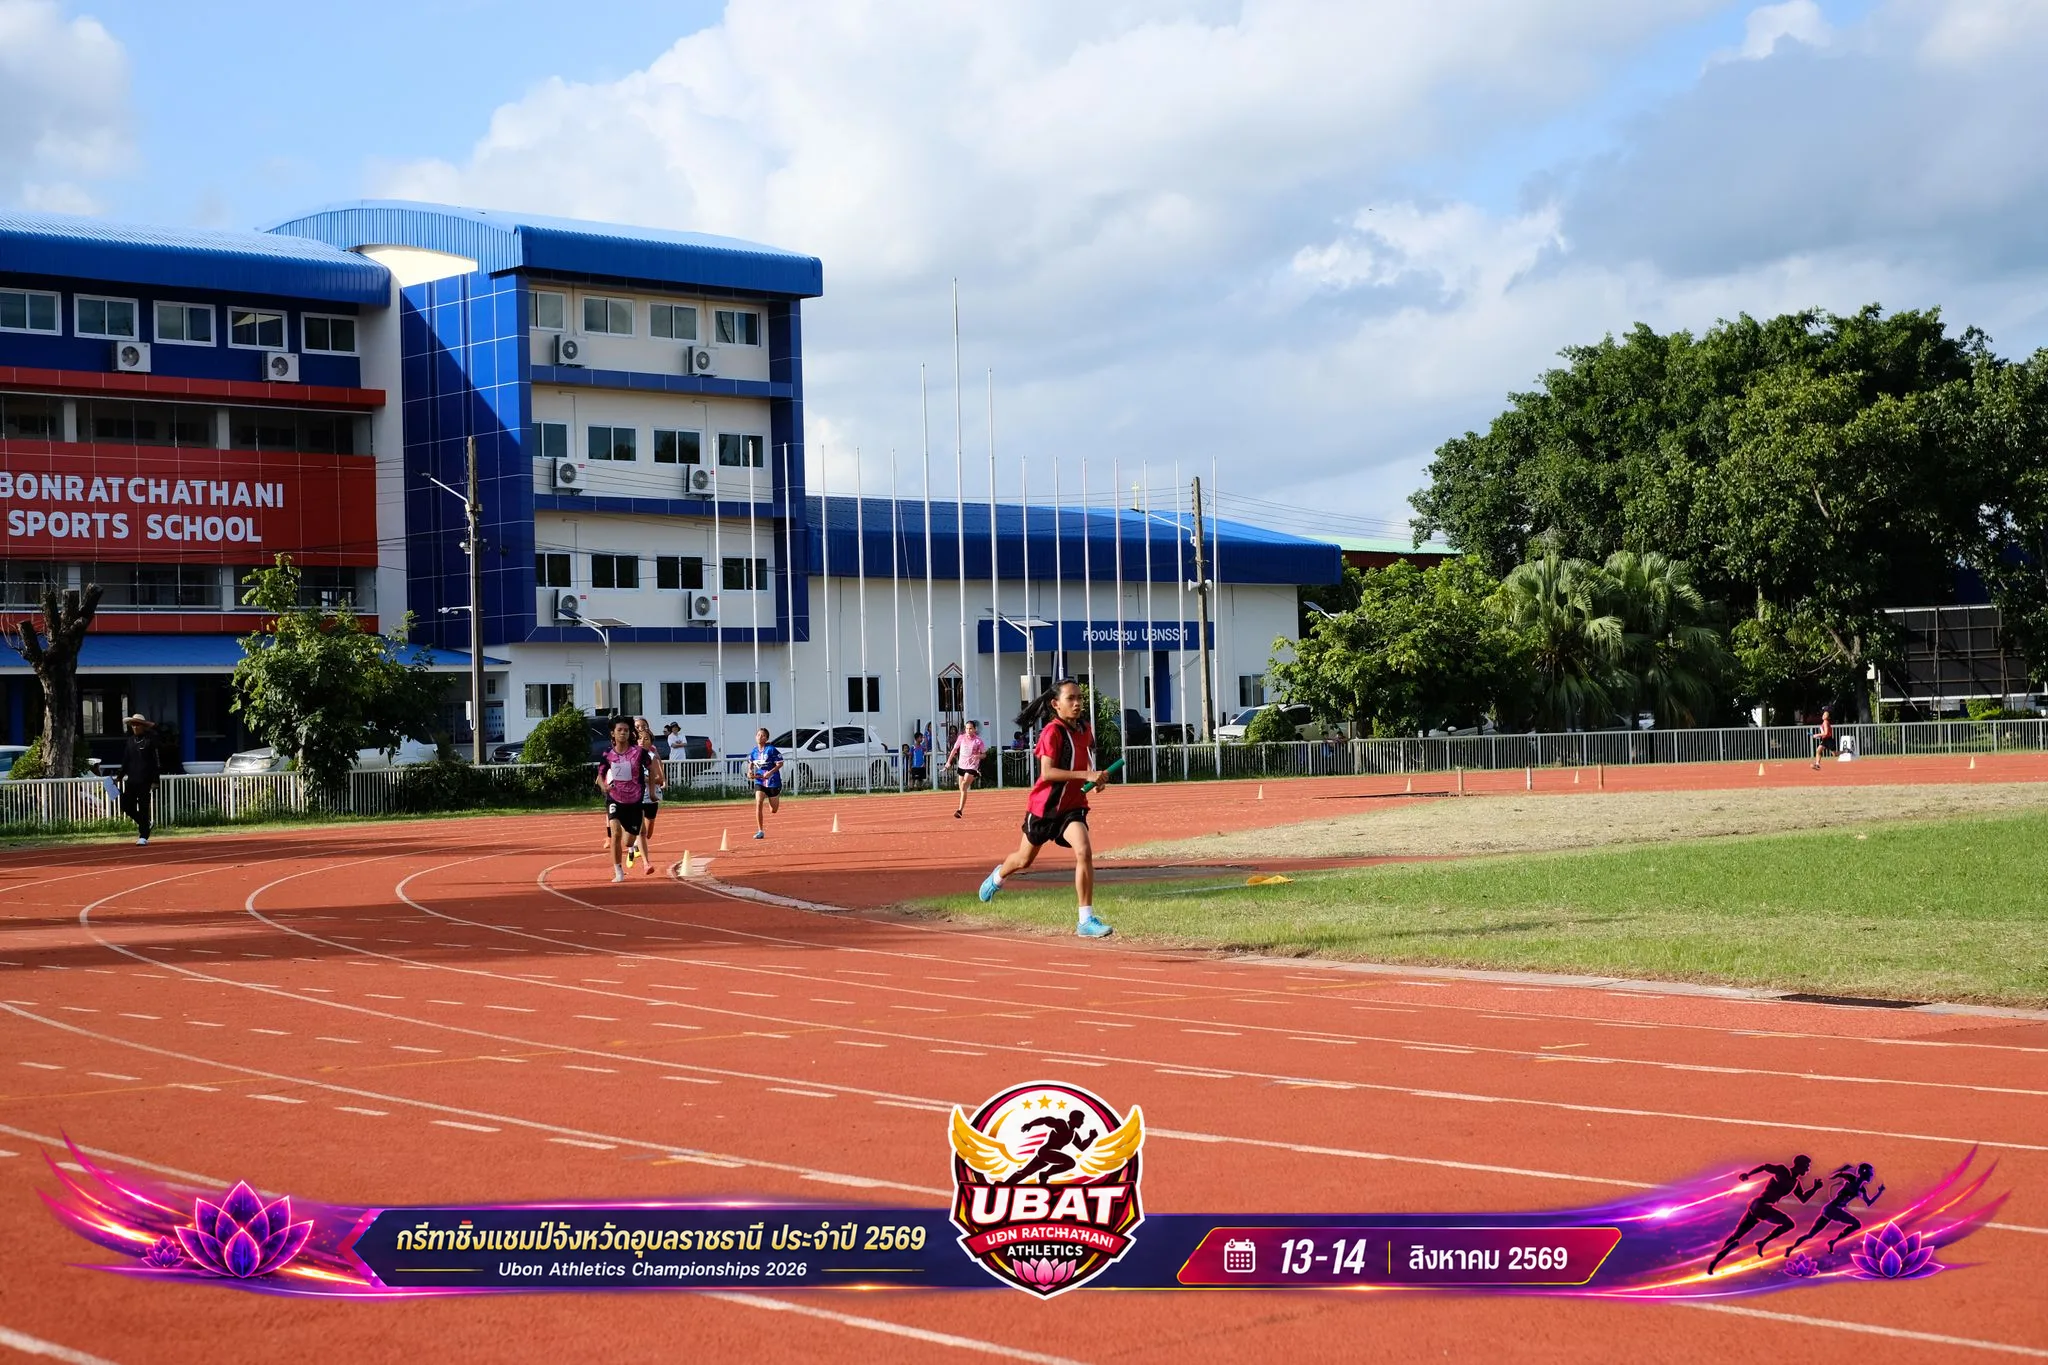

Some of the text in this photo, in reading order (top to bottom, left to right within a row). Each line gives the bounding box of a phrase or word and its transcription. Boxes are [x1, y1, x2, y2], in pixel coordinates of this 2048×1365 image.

[0, 472, 284, 508] BONRATCHATHANI
[8, 509, 262, 543] SPORTS SCHOOL
[1083, 627, 1137, 645] ห้องปรชุม
[609, 803, 617, 814] 6
